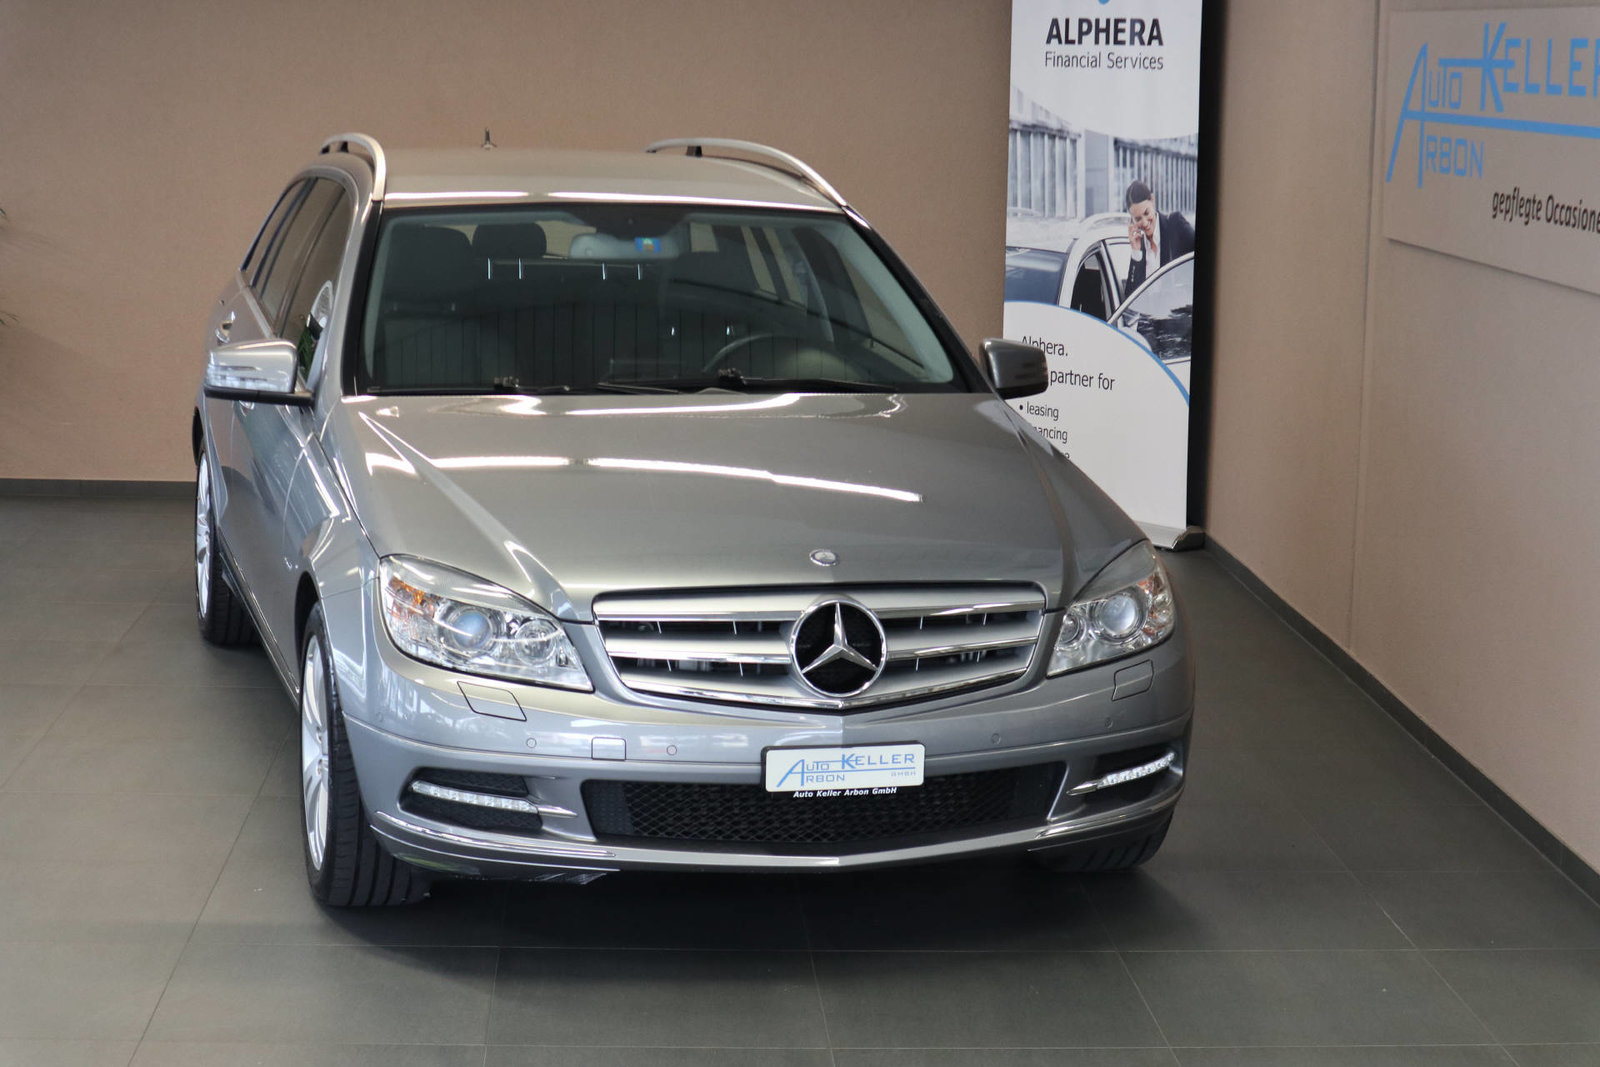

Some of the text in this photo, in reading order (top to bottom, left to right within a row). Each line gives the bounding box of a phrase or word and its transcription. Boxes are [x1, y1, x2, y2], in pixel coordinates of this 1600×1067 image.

[1045, 18, 1164, 46] ALPHERA
[1045, 51, 1164, 70] Financial Services
[1492, 187, 1542, 226] gepflegte
[1050, 370, 1116, 390] partner for
[1027, 401, 1059, 421] leasing
[841, 753, 915, 769] KELLER
[793, 787, 897, 798] Auto Keller Arbon GmbH
